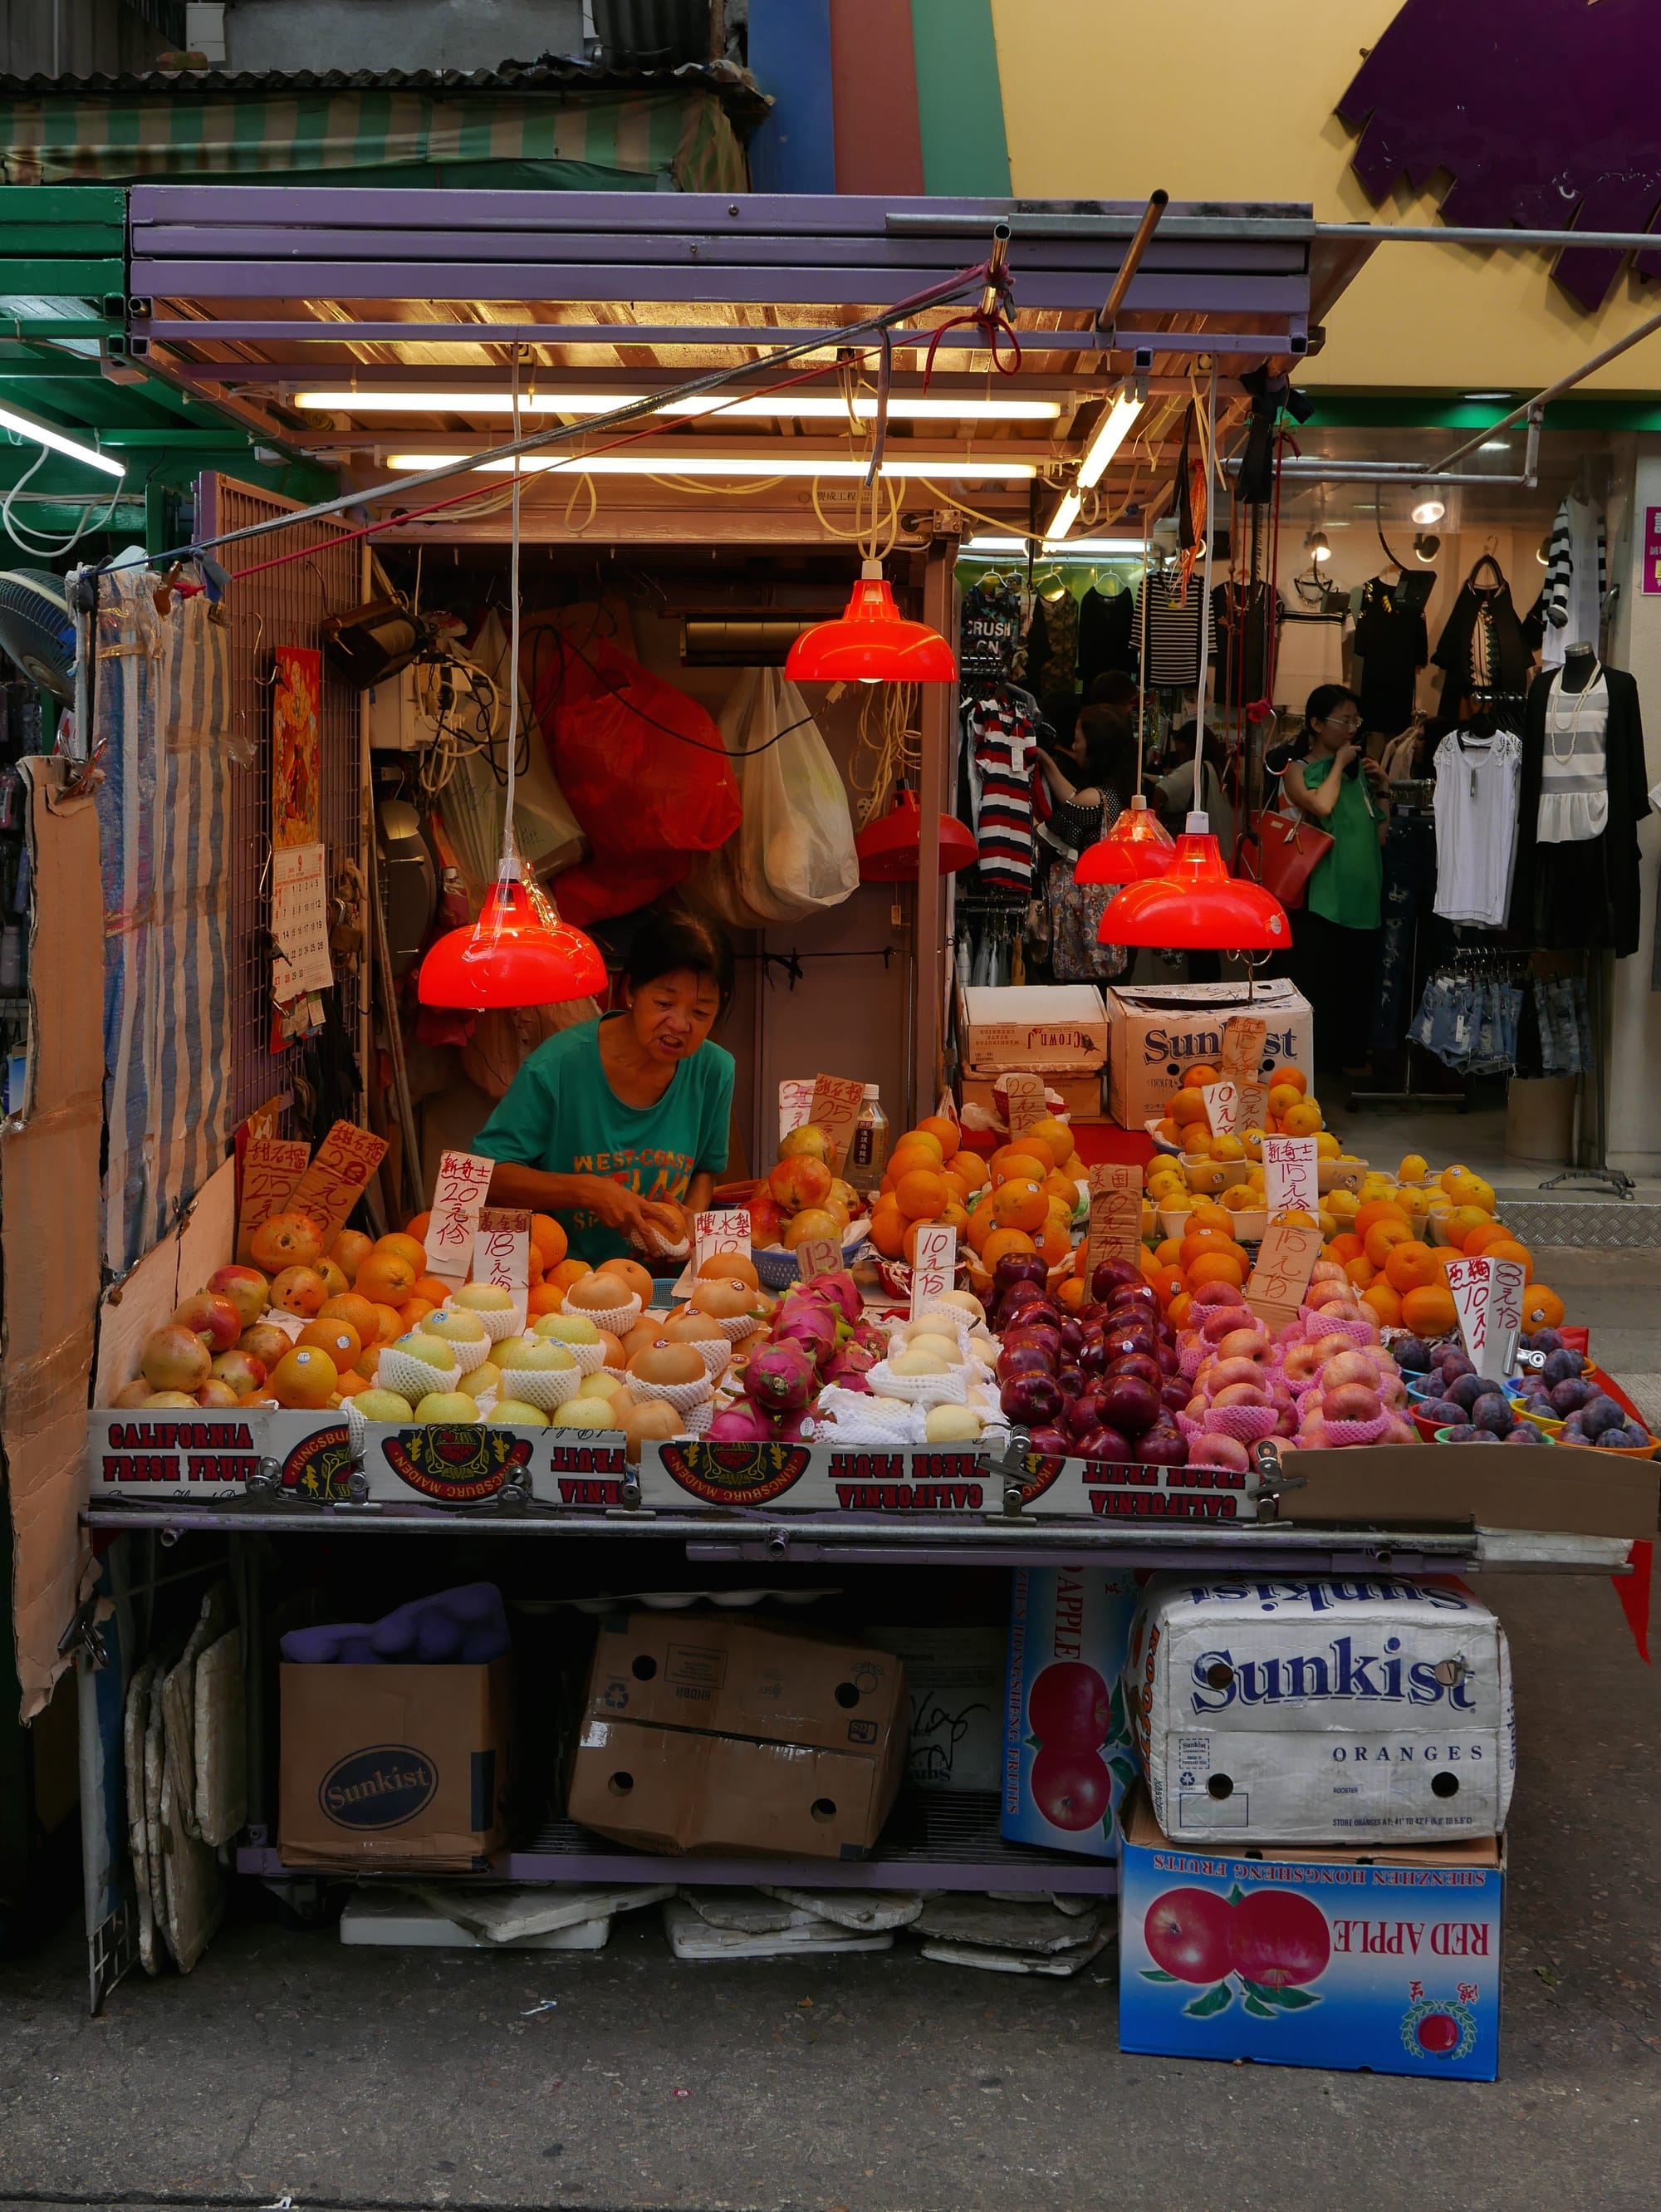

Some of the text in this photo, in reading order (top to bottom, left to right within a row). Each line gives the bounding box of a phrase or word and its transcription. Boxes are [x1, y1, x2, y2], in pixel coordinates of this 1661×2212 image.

[1041, 1032, 1080, 1048] Crown
[1144, 1022, 1297, 1065] Sunst
[1209, 1086, 1233, 1104] 10
[809, 1101, 853, 1124] 25
[1281, 1164, 1306, 1184] 15
[246, 1174, 292, 1202] 25
[440, 1183, 479, 1203] 20
[484, 1234, 514, 1257] 18
[921, 1232, 948, 1255] 10
[1275, 1230, 1307, 1253] 15
[1463, 1285, 1489, 1315] 10
[108, 1423, 254, 1449] CALIFORNIA
[291, 1429, 350, 1476] KINGSBU
[551, 1447, 625, 1473] FRUIT
[829, 1453, 991, 1479] FRUIT FRESH
[102, 1455, 262, 1482] FRESH FRUIT
[394, 1455, 441, 1494] MAIDEN
[671, 1458, 799, 1503] KINGSBURG MAIDEN
[1082, 1460, 1246, 1489] FRUIT FRESH
[835, 1483, 984, 1509] CALIFORNIA
[1089, 1489, 1237, 1517] CALIFORNIA
[1183, 1580, 1470, 1613] Sunkist
[1053, 1575, 1084, 1660] APPLE
[1007, 1625, 1026, 1743] HONGSHENG
[1191, 1636, 1477, 1715] Sunkist
[1332, 1744, 1482, 1762] ORANGES
[327, 1766, 431, 1811] Sunkist
[1007, 1748, 1021, 1815] FRUITS
[1332, 1818, 1354, 1827] STORE
[1354, 1818, 1381, 1827] ORANGES
[1405, 1817, 1414, 1826] TO
[1444, 1817, 1453, 1825] TO
[1154, 1854, 1485, 1886] SHENZHEN HONGSHENG FRUITS
[1333, 1919, 1490, 1957] RED APPLE
[1409, 1980, 1424, 2003] 生
